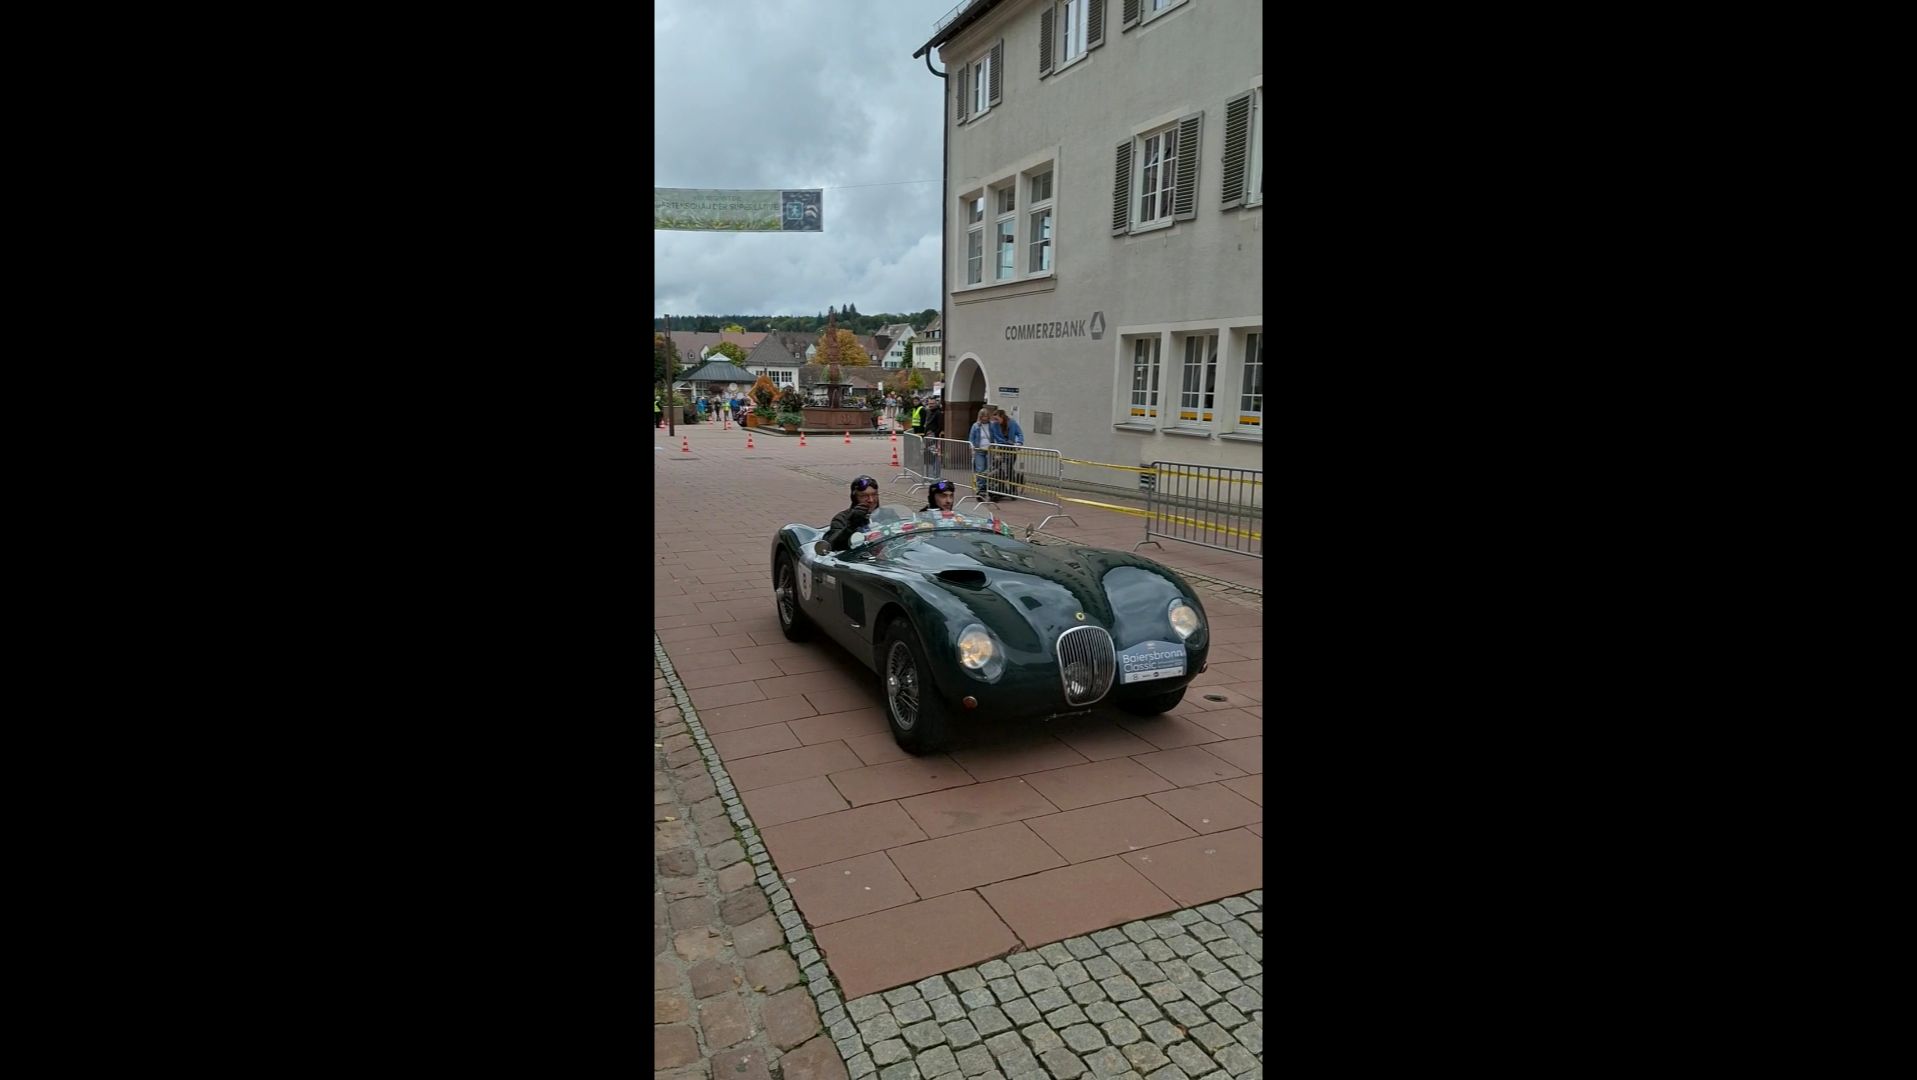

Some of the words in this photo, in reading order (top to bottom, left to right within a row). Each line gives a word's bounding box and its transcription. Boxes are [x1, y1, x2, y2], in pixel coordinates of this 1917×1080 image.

[1005, 320, 1086, 340] COMMERZBANK
[1122, 649, 1183, 664] Baiersbronn
[1124, 661, 1157, 673] Classic
